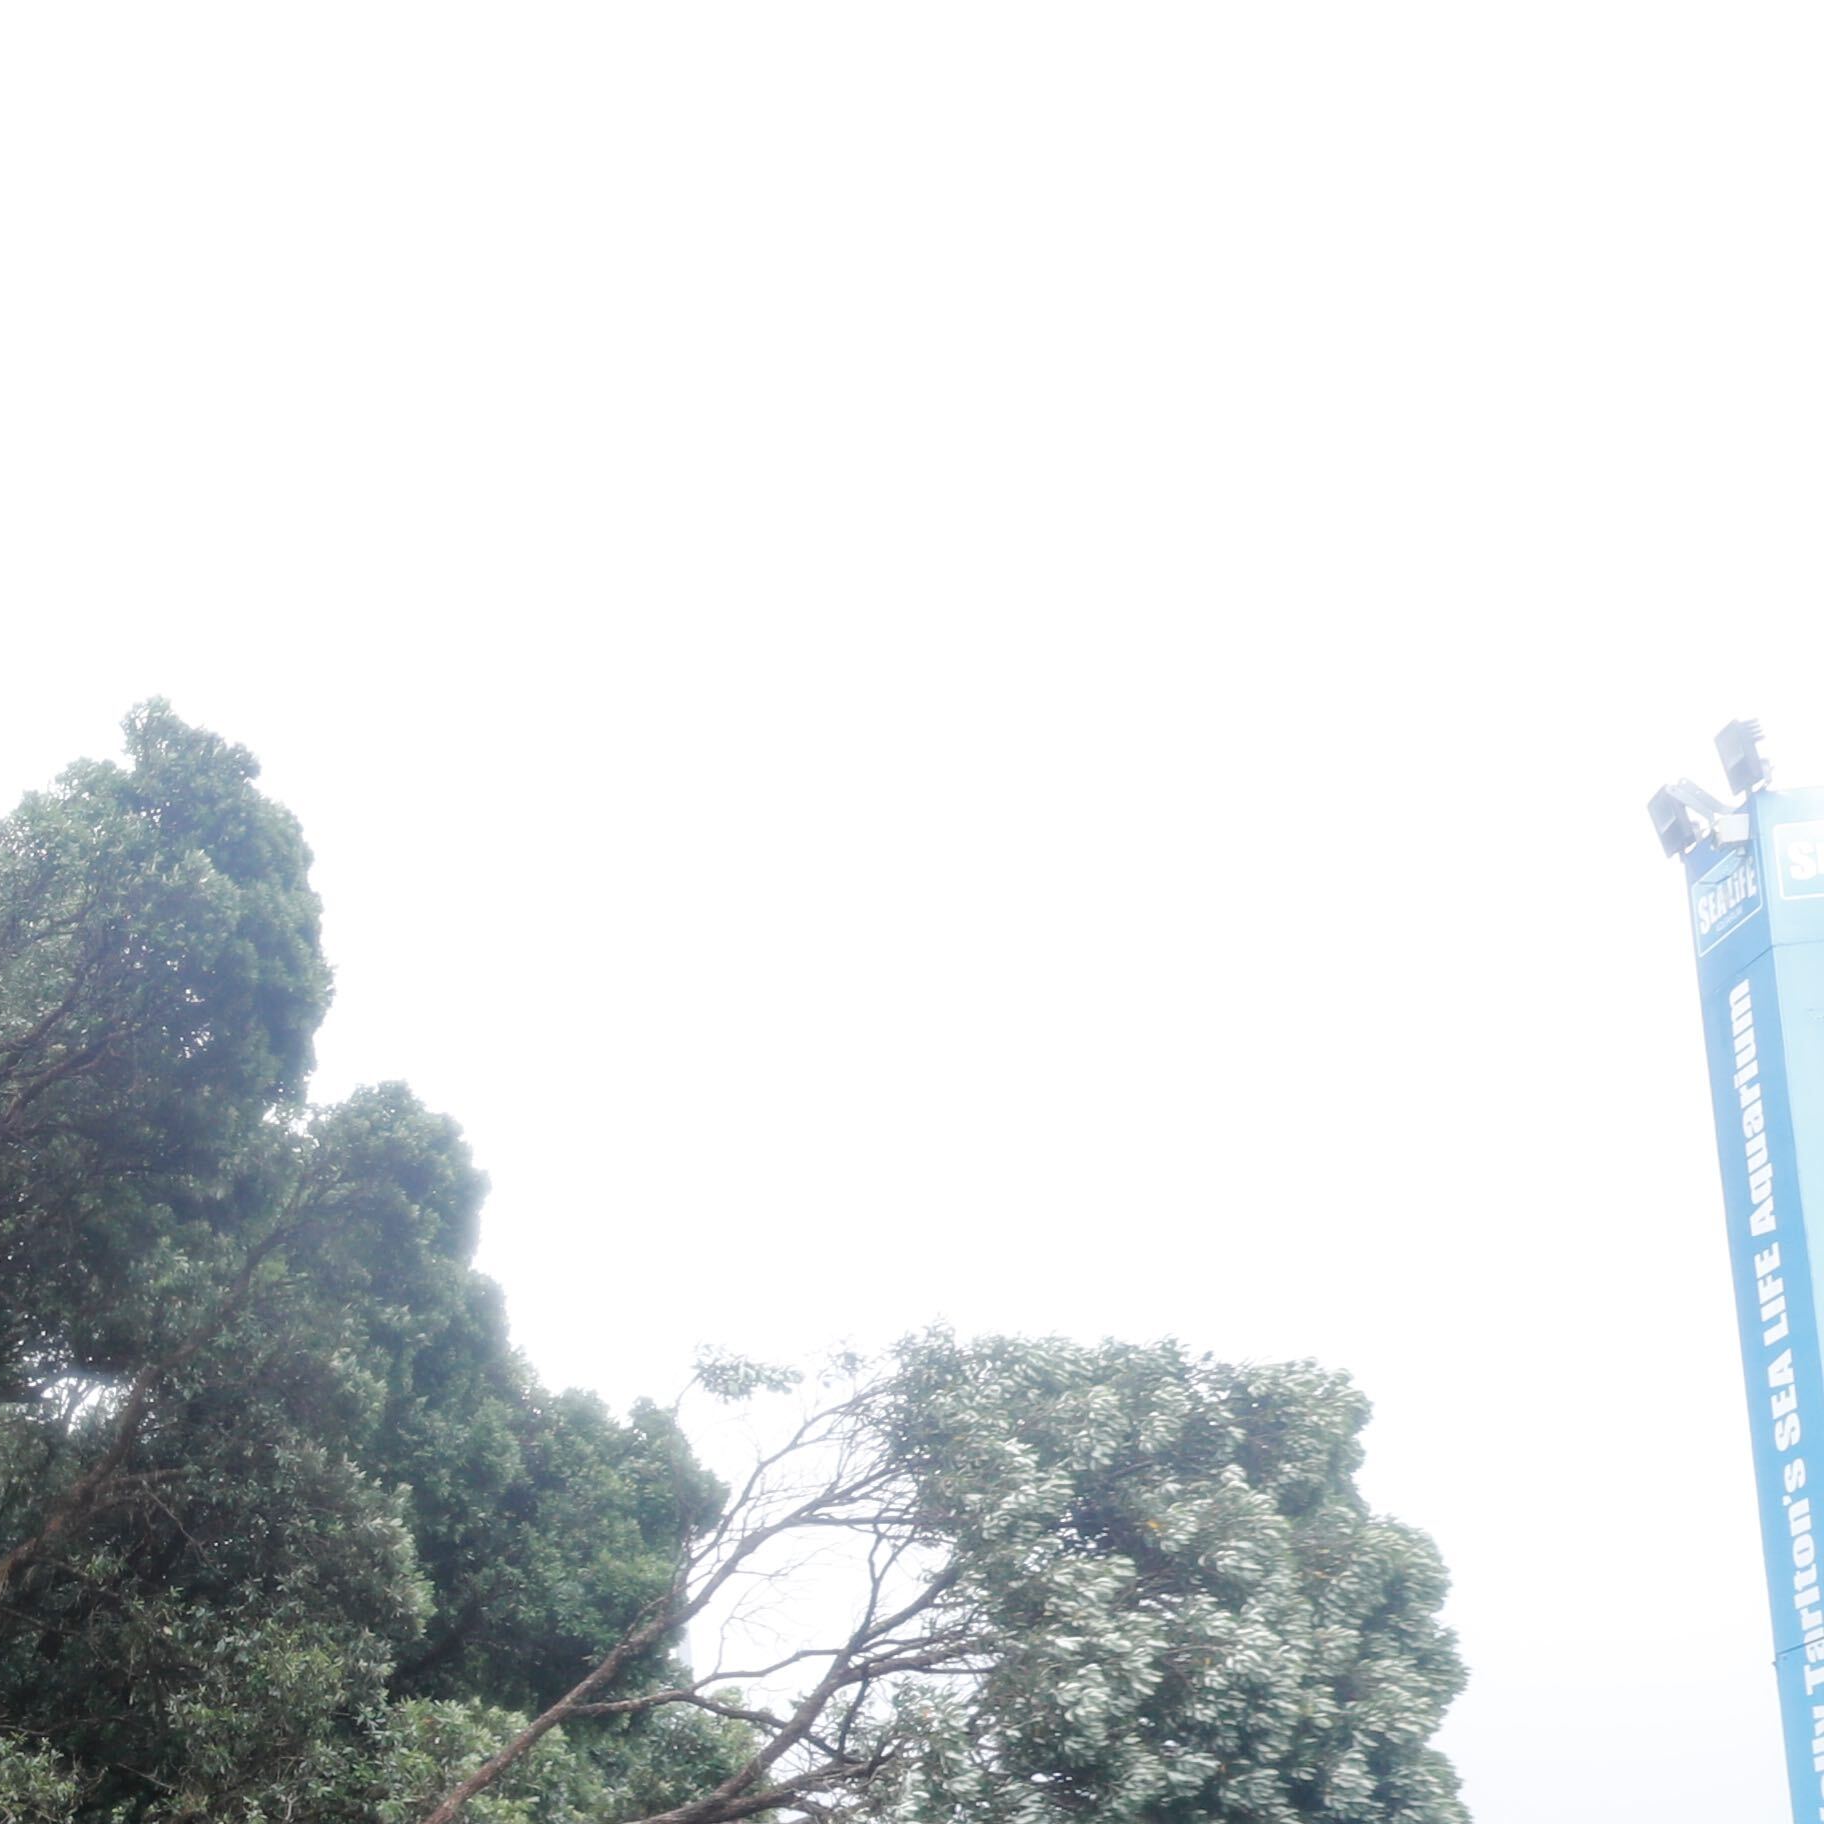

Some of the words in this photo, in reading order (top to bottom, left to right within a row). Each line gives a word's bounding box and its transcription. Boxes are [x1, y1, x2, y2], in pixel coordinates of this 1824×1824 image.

[1728, 979, 1778, 1237] Aquarium
[1754, 1241, 1789, 1347] LIFE
[1768, 1348, 1801, 1452] SEA
